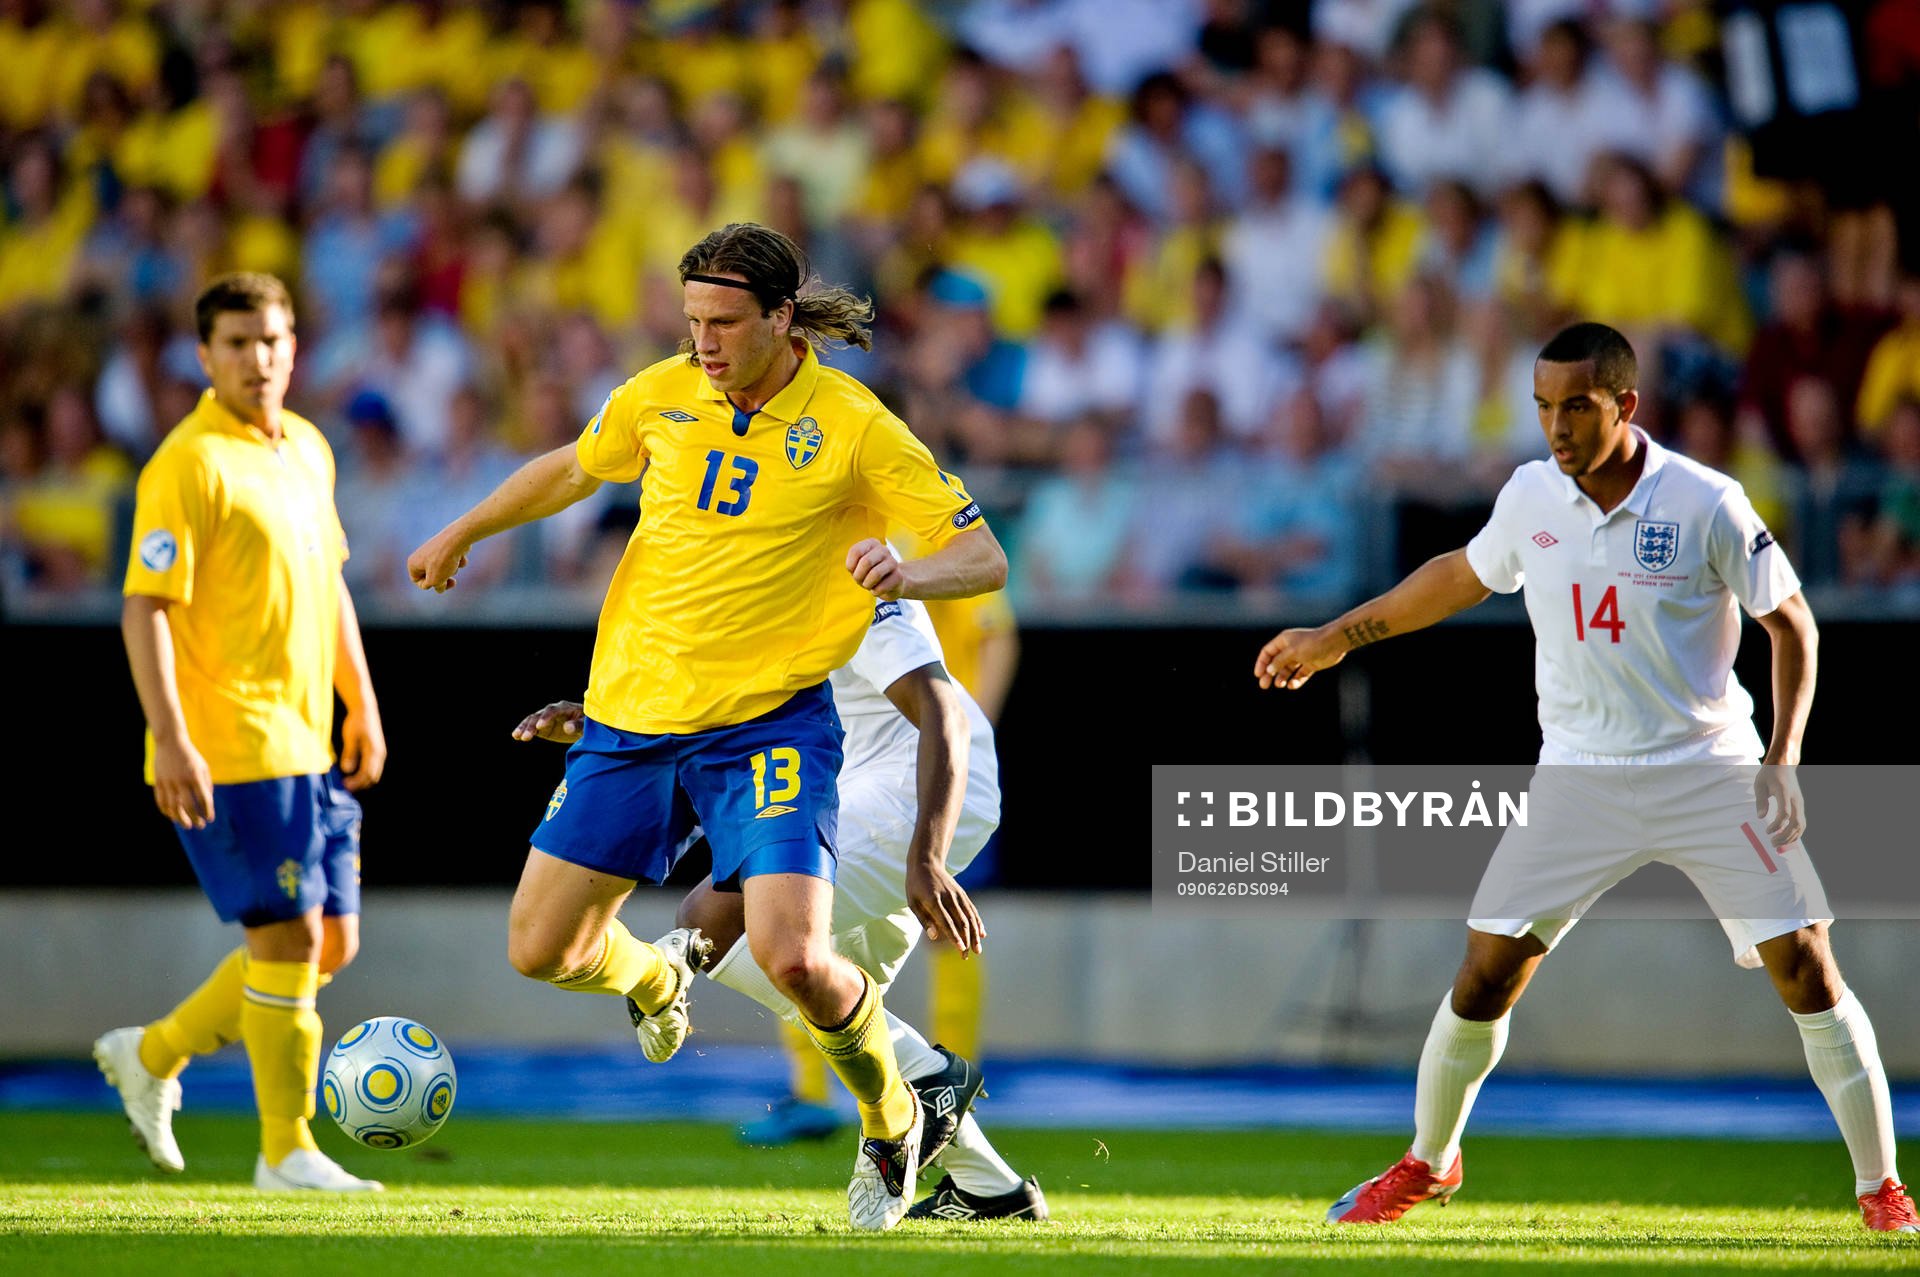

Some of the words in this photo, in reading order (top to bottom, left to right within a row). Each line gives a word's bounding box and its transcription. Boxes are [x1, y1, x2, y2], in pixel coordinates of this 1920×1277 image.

[697, 449, 759, 517] 13
[1571, 583, 1626, 644] 14
[749, 747, 802, 809] 13
[1740, 822, 1788, 874] 1
